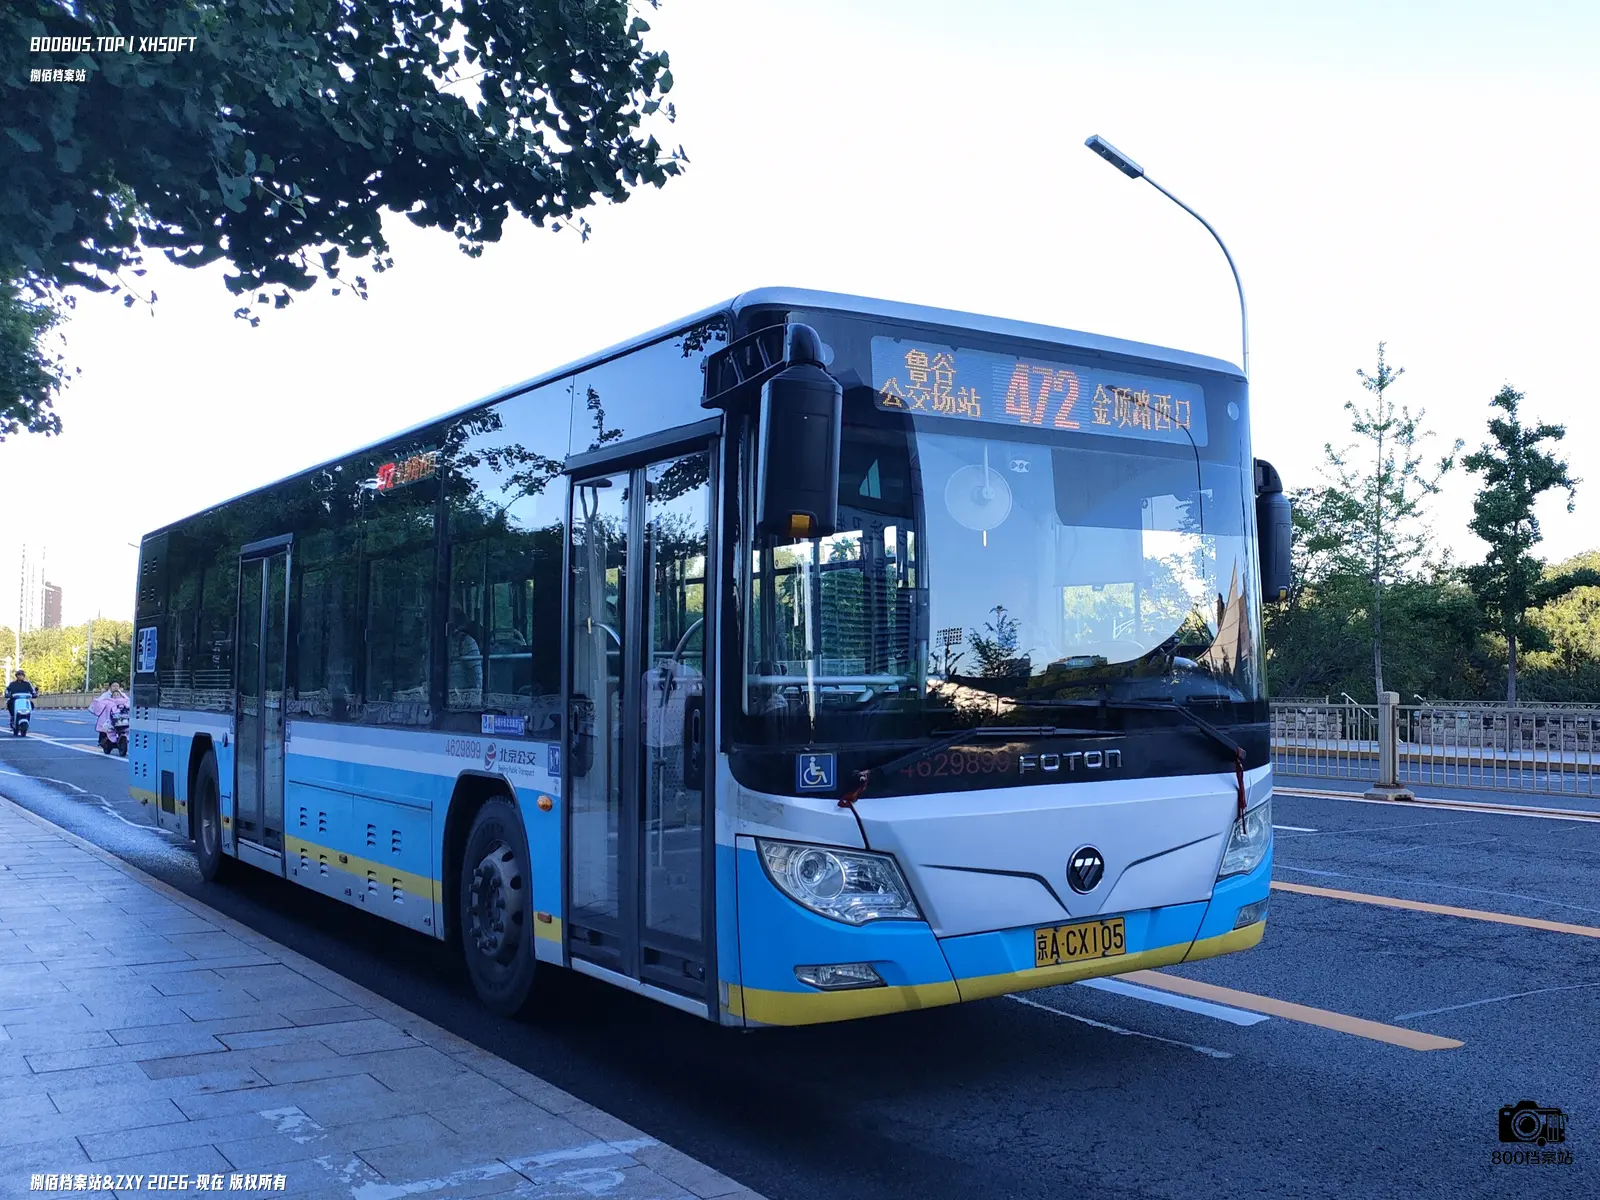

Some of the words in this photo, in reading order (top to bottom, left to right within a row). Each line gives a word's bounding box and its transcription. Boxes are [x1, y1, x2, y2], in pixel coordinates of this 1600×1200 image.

[905, 349, 956, 388] 鲁谷
[880, 377, 980, 418] 公交场站
[1005, 364, 1080, 430] 472
[1092, 383, 1191, 432] 金顶路西口
[445, 739, 481, 759] 4629899
[499, 747, 536, 766] 北京公交
[1018, 749, 1122, 775] FOTON
